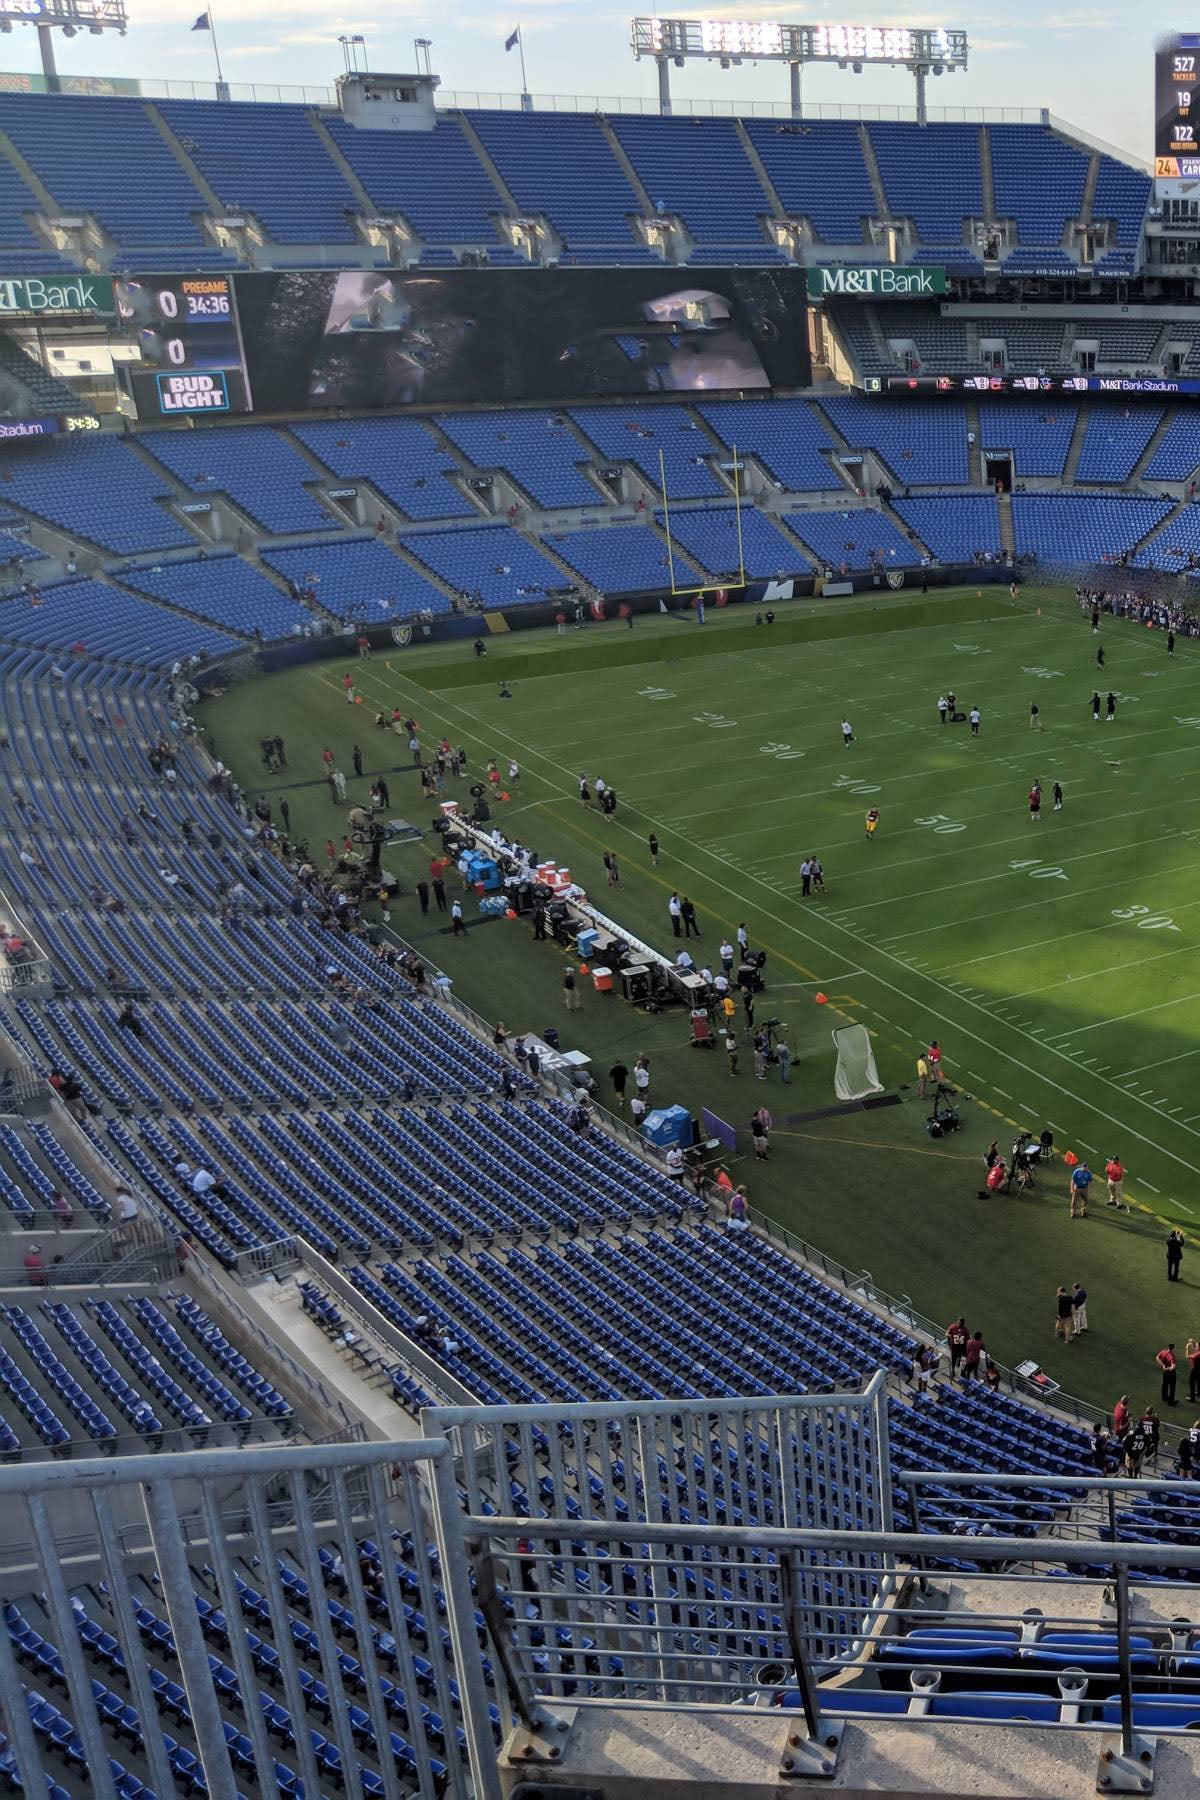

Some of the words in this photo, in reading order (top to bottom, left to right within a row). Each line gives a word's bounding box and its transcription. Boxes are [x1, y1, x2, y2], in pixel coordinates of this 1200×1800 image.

[1174, 56, 1195, 72] 527
[1177, 91, 1191, 107] 19
[1174, 126, 1193, 141] 122
[1157, 159, 1171, 175] 24
[182, 281, 228, 294] PREGAME
[821, 268, 879, 293] M&T
[881, 269, 933, 293] Bank
[26, 278, 98, 309] Bank
[159, 290, 178, 318] 0
[188, 296, 230, 314] 34:36
[168, 338, 186, 364] 0
[169, 376, 214, 393] BUD
[1100, 379, 1122, 390] M&T
[1122, 380, 1143, 391] Bank
[1144, 381, 1178, 392] Stadium
[162, 390, 224, 409] LIGHT
[637, 686, 677, 700] 10
[692, 712, 738, 728] 20
[759, 741, 805, 760] 30
[832, 774, 882, 795] 40
[913, 814, 968, 834] 50
[1008, 859, 1066, 880] 40
[1111, 904, 1176, 930] 30
[953, 1334, 965, 1345] 24
[1189, 1431, 1198, 1442] 5
[1131, 1441, 1144, 1451] 20
